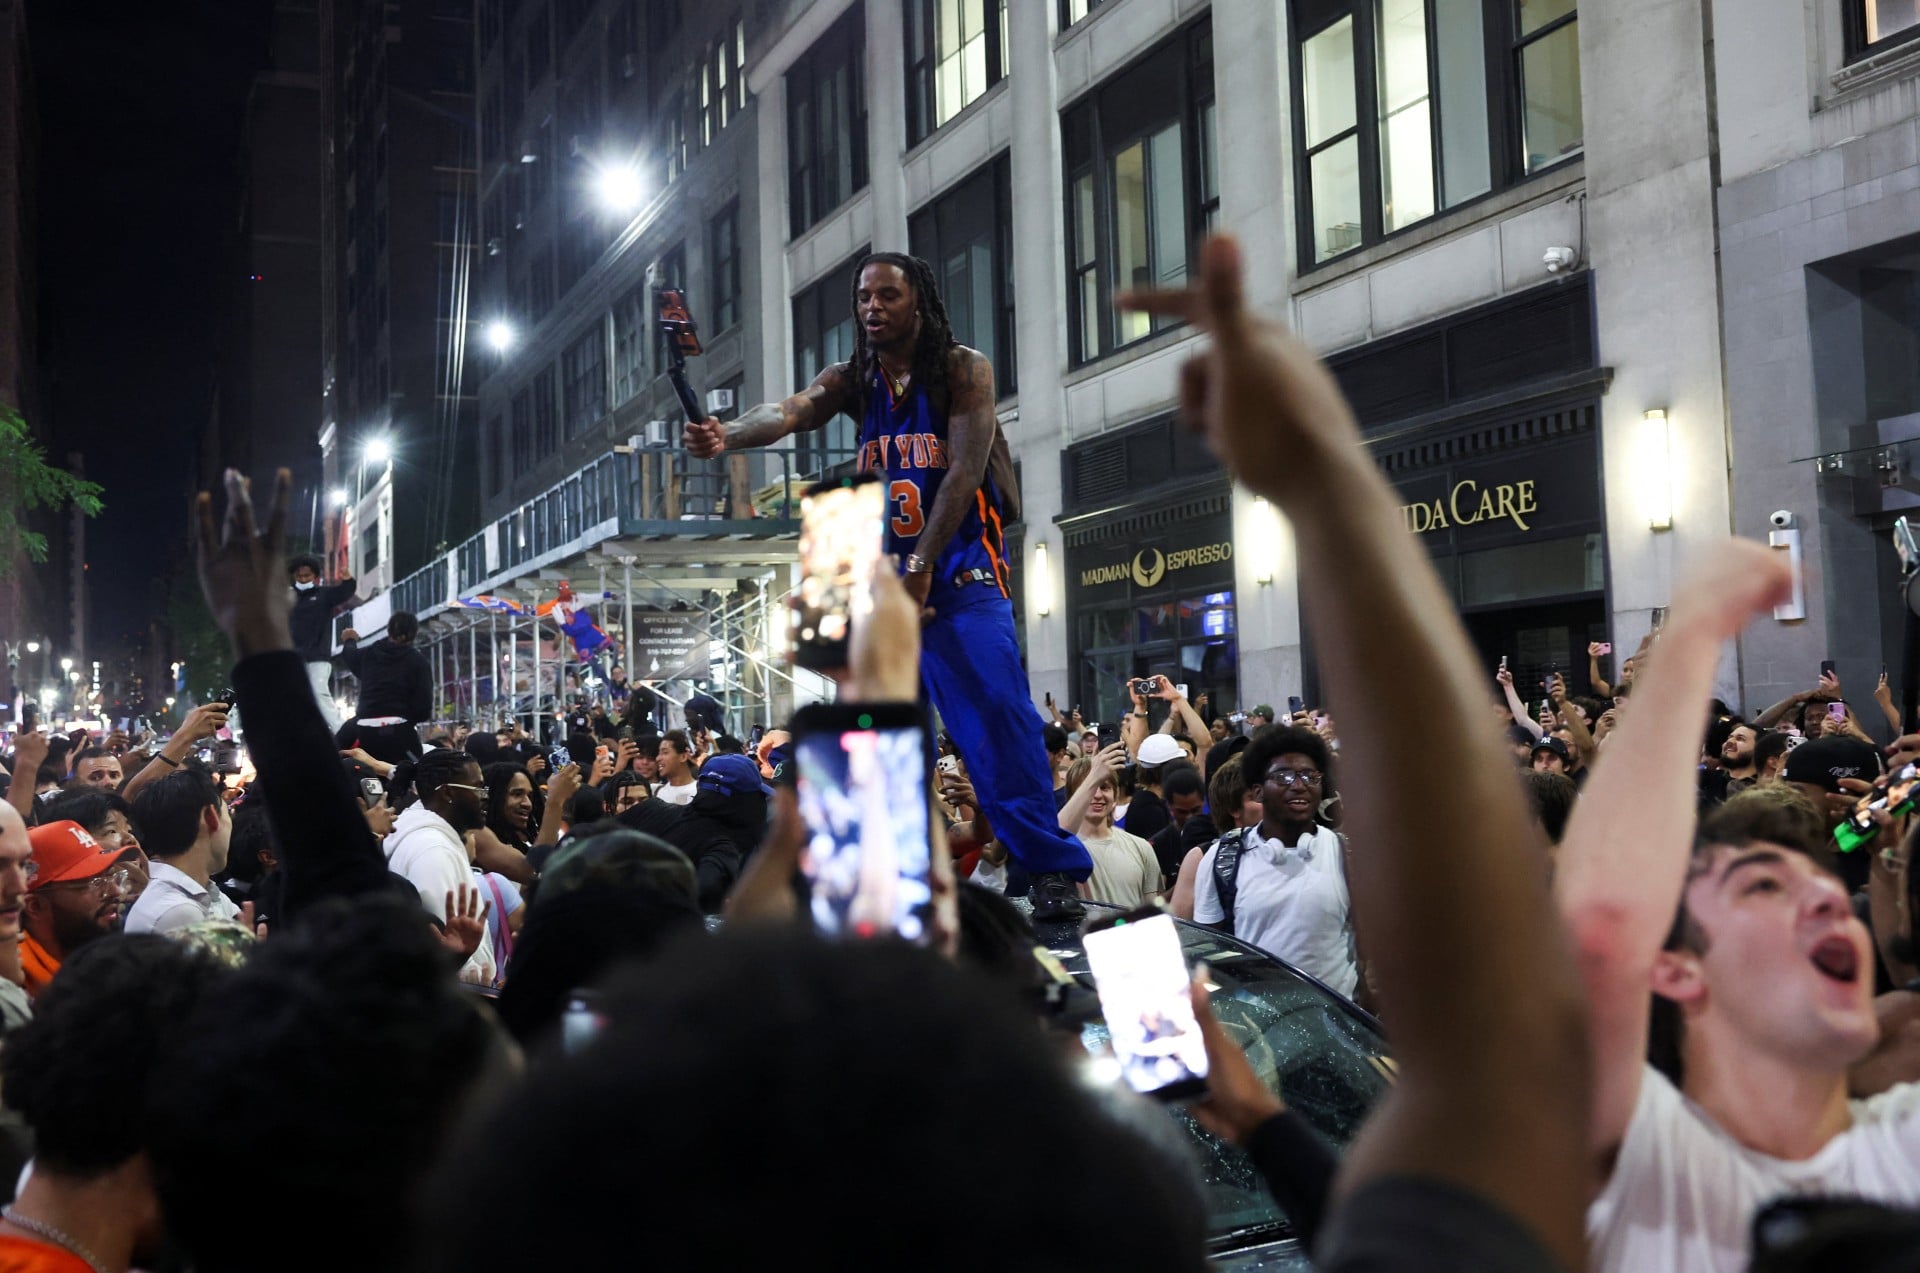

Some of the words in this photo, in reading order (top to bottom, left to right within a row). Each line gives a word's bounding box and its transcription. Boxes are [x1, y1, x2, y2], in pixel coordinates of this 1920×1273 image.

[895, 433, 949, 470] YOR
[890, 479, 925, 537] 3
[1081, 561, 1131, 587] MADMAN
[1166, 541, 1232, 571] ESPRESSO
[650, 627, 663, 635] FOR
[67, 827, 98, 848] LA
